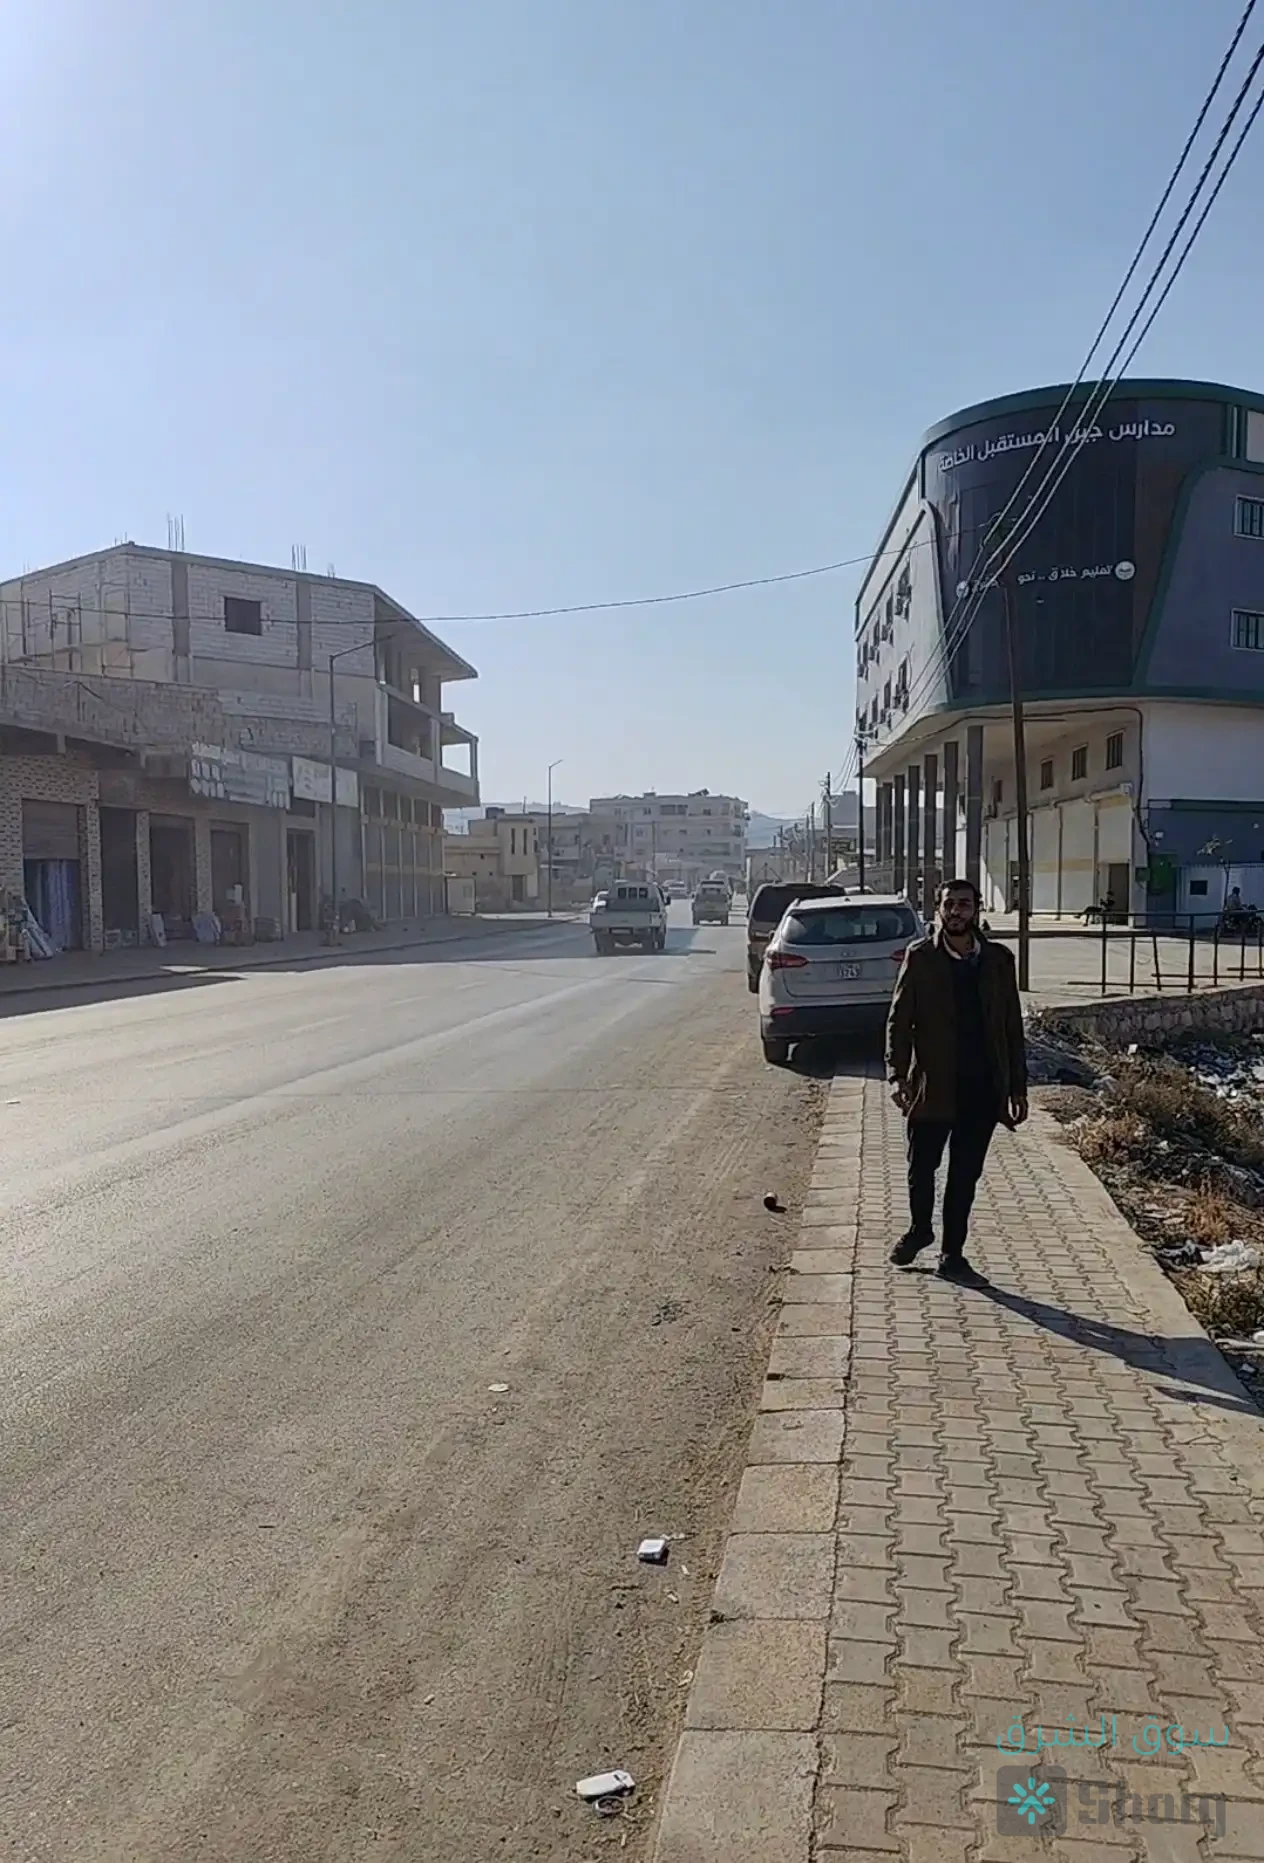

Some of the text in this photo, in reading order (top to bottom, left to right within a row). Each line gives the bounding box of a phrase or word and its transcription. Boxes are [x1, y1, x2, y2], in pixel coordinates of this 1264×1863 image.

[977, 426, 1060, 462] المستقبل
[1109, 420, 1176, 441] مدارس
[938, 444, 975, 472] الخاصة
